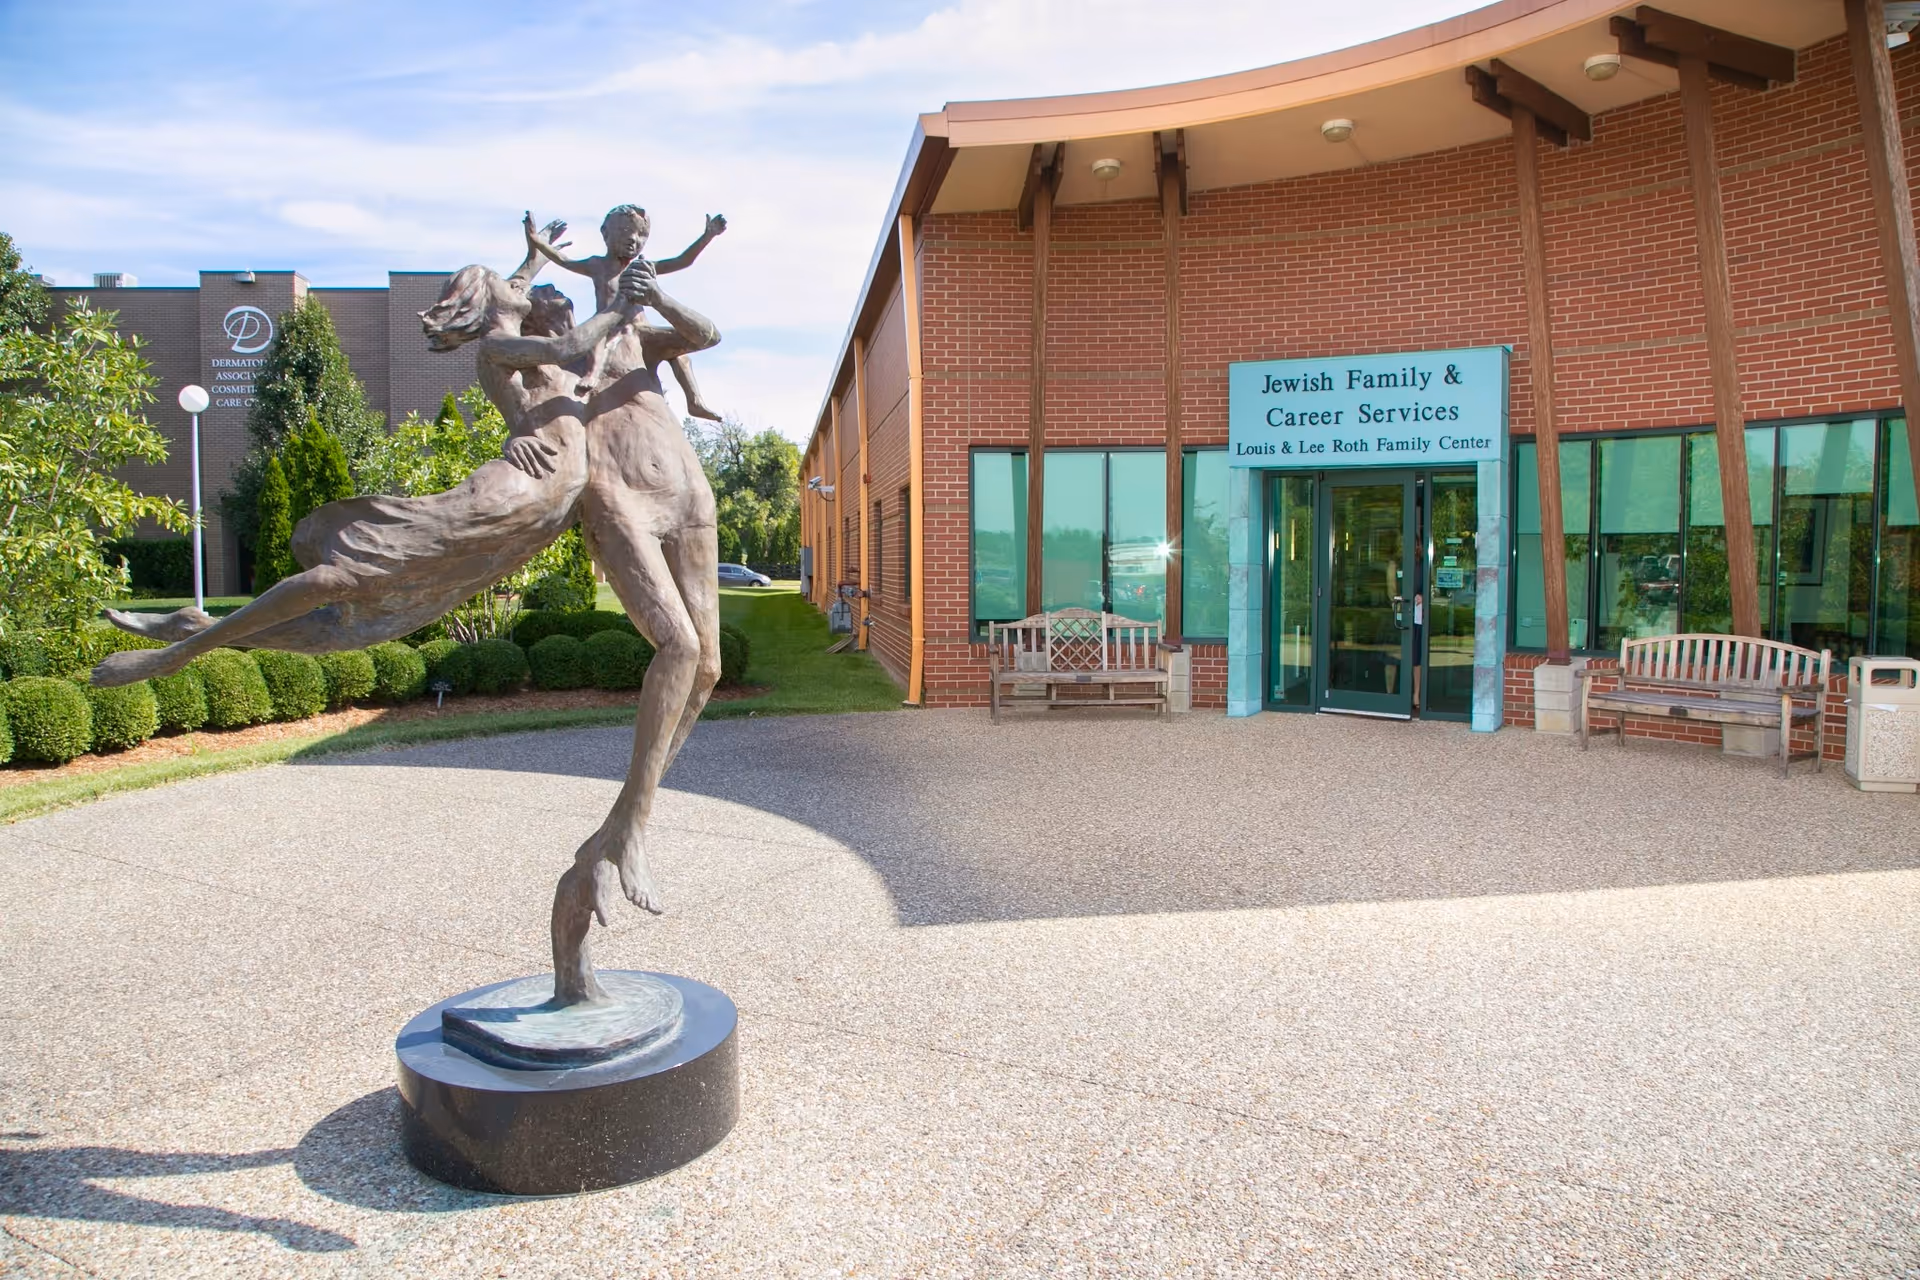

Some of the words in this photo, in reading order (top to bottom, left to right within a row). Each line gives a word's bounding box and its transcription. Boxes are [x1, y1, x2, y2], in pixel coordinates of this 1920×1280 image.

[1262, 372, 1333, 393] Jewish
[1346, 367, 1432, 391] Family
[1444, 364, 1463, 385] &
[211, 385, 257, 394] COSMETI
[216, 399, 241, 407] CARE
[1266, 407, 1343, 427] Career
[1358, 402, 1459, 424] Services
[1236, 443, 1275, 456] Louis
[1281, 441, 1292, 455] &
[1299, 440, 1325, 454] Lee
[1332, 439, 1369, 453] Roth
[1376, 437, 1431, 453] Family
[1438, 435, 1492, 450] Center
